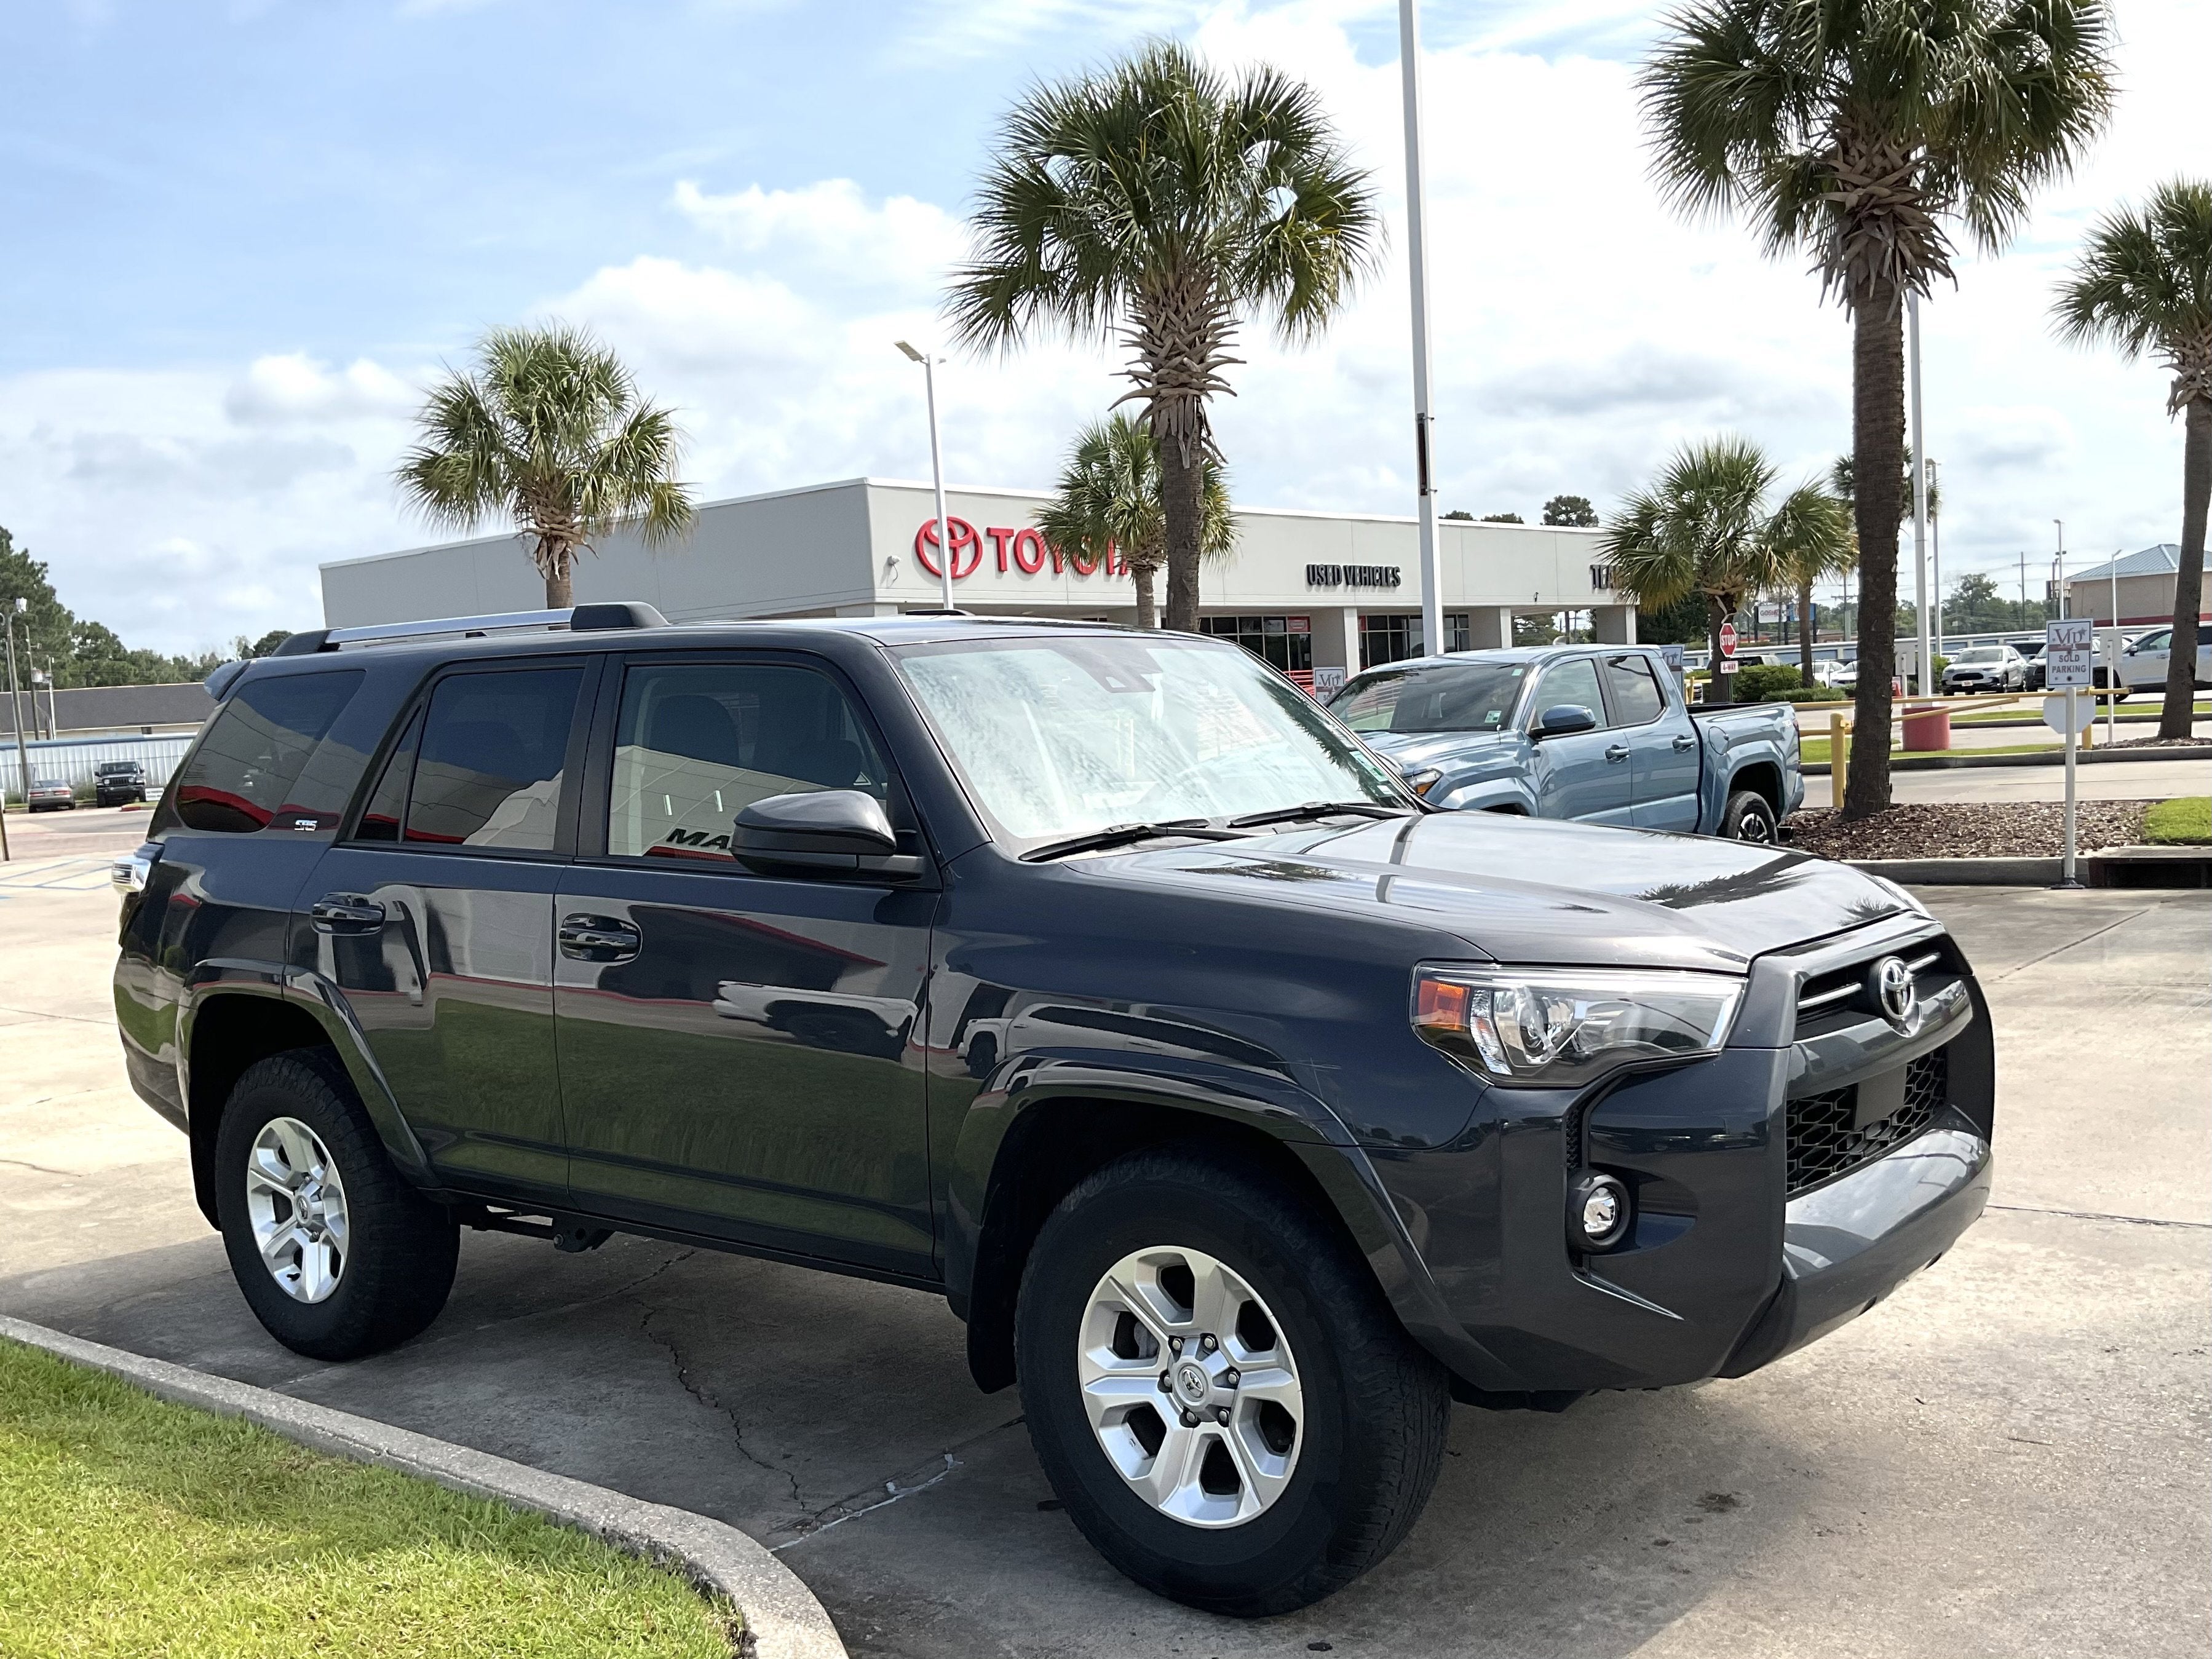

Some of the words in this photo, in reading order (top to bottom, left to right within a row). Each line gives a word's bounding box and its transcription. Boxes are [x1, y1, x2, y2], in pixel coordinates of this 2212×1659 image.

[1306, 564, 1342, 585] USED
[1342, 565, 1401, 586] VEHICLES
[1721, 634, 1734, 646] STOP
[2051, 665, 2086, 673] PARKING
